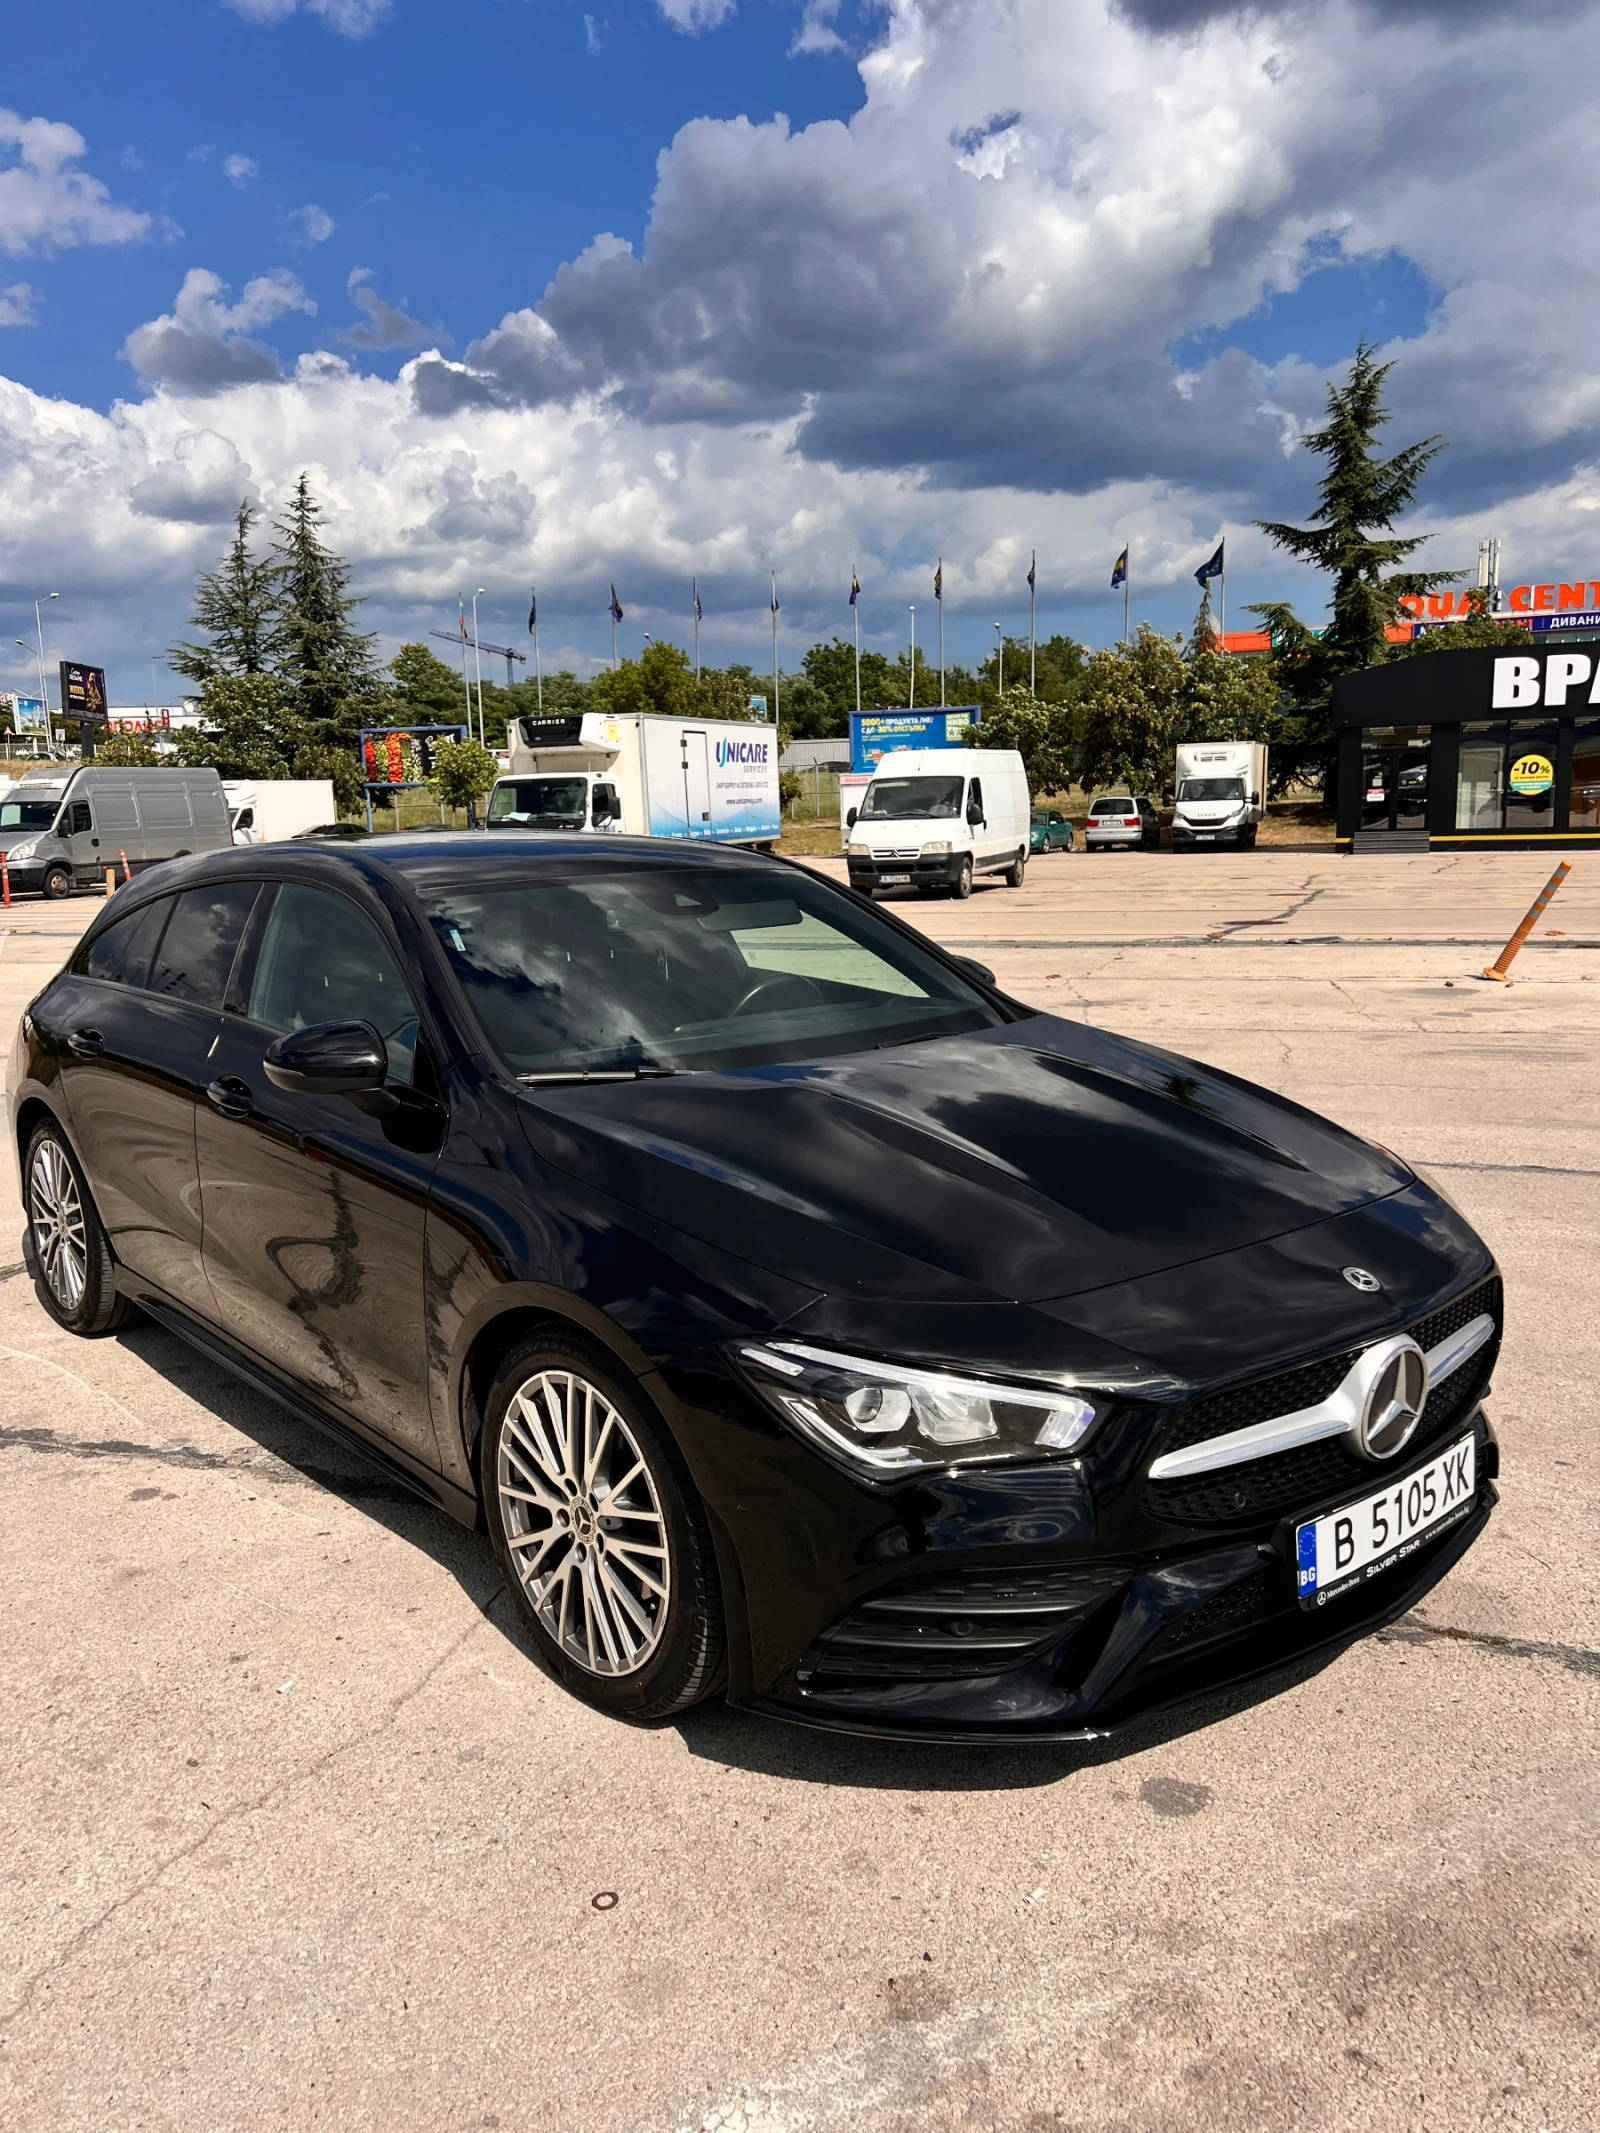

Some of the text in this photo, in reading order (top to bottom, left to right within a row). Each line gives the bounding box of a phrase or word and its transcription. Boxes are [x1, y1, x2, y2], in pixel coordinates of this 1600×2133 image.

[532, 718, 566, 726] CARRIER
[885, 717, 919, 726] ПРОДУКТА
[715, 737, 768, 767] UNICARE
[743, 765, 767, 773] SERVICES
[1513, 761, 1550, 775] -10%
[1335, 1445, 1470, 1571] B 5105 XK
[1301, 1566, 1316, 1586] BG
[1326, 1576, 1360, 1599] Mercedes-Benz
